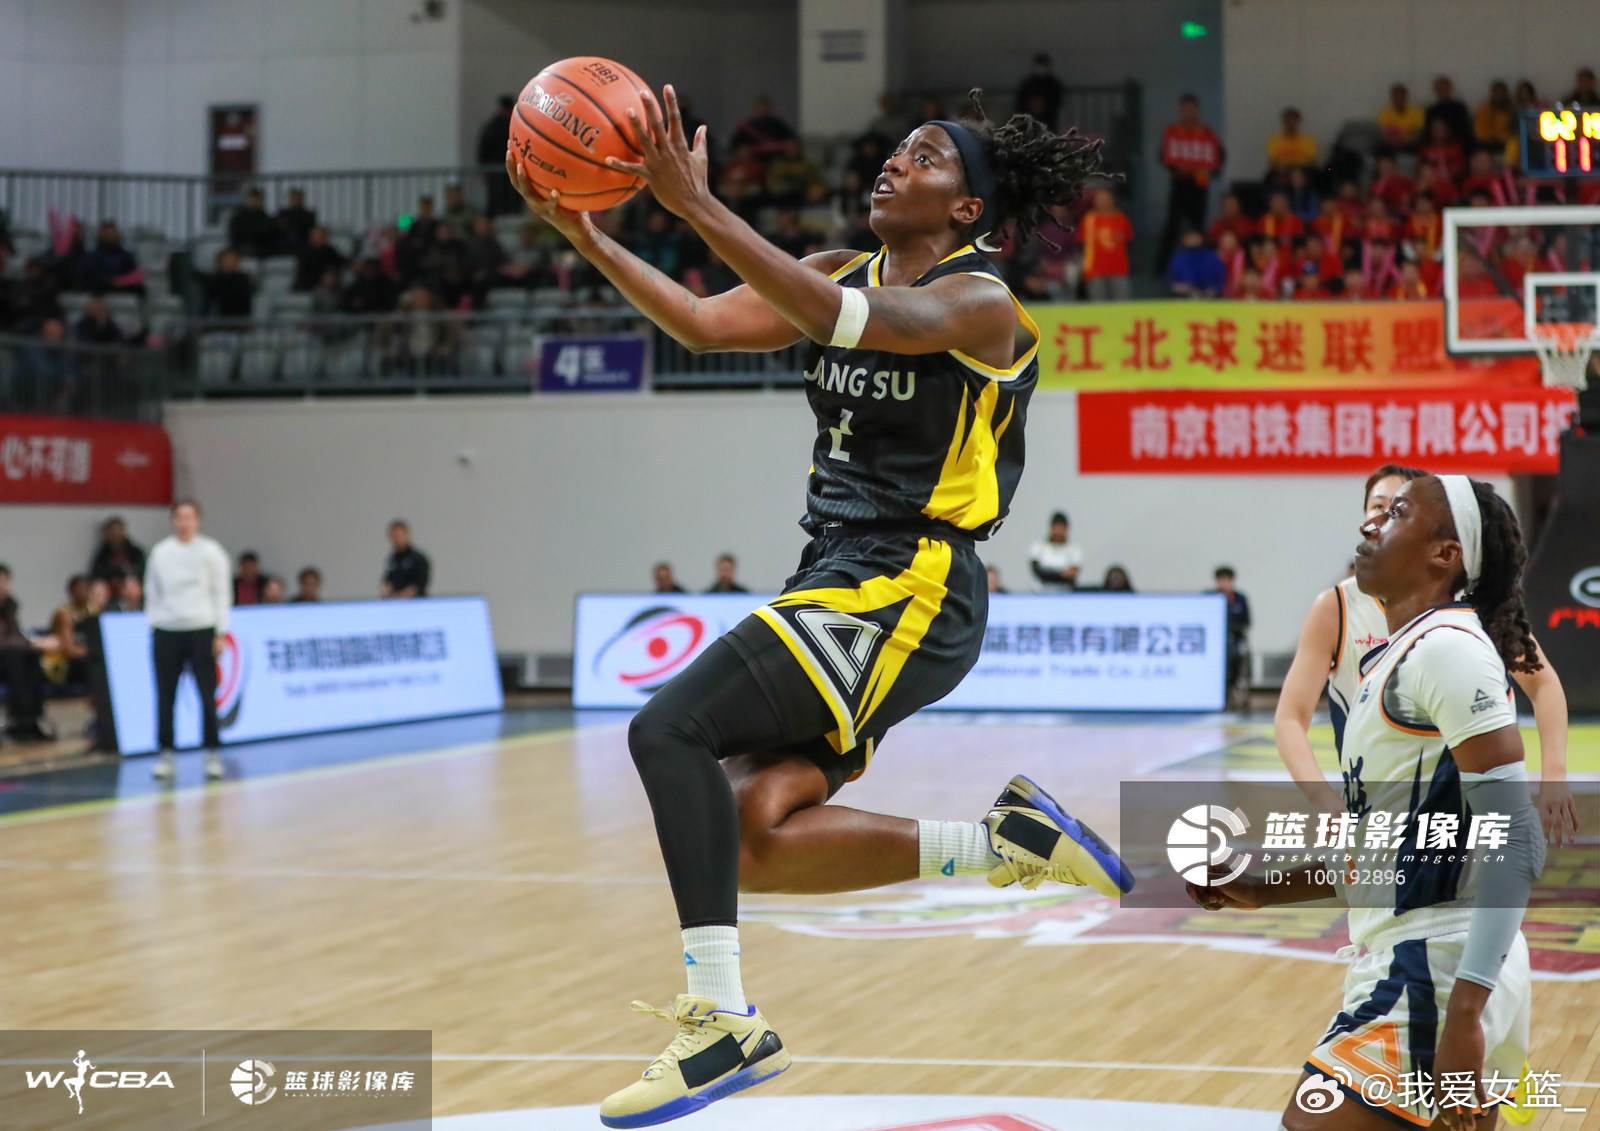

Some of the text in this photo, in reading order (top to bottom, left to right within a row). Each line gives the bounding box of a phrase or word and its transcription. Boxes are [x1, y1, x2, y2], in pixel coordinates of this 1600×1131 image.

[589, 62, 619, 83] FIBA
[1055, 318, 1442, 374] 江北球迷联盟
[872, 370, 916, 401] SU
[1470, 700, 1498, 715] PEAK
